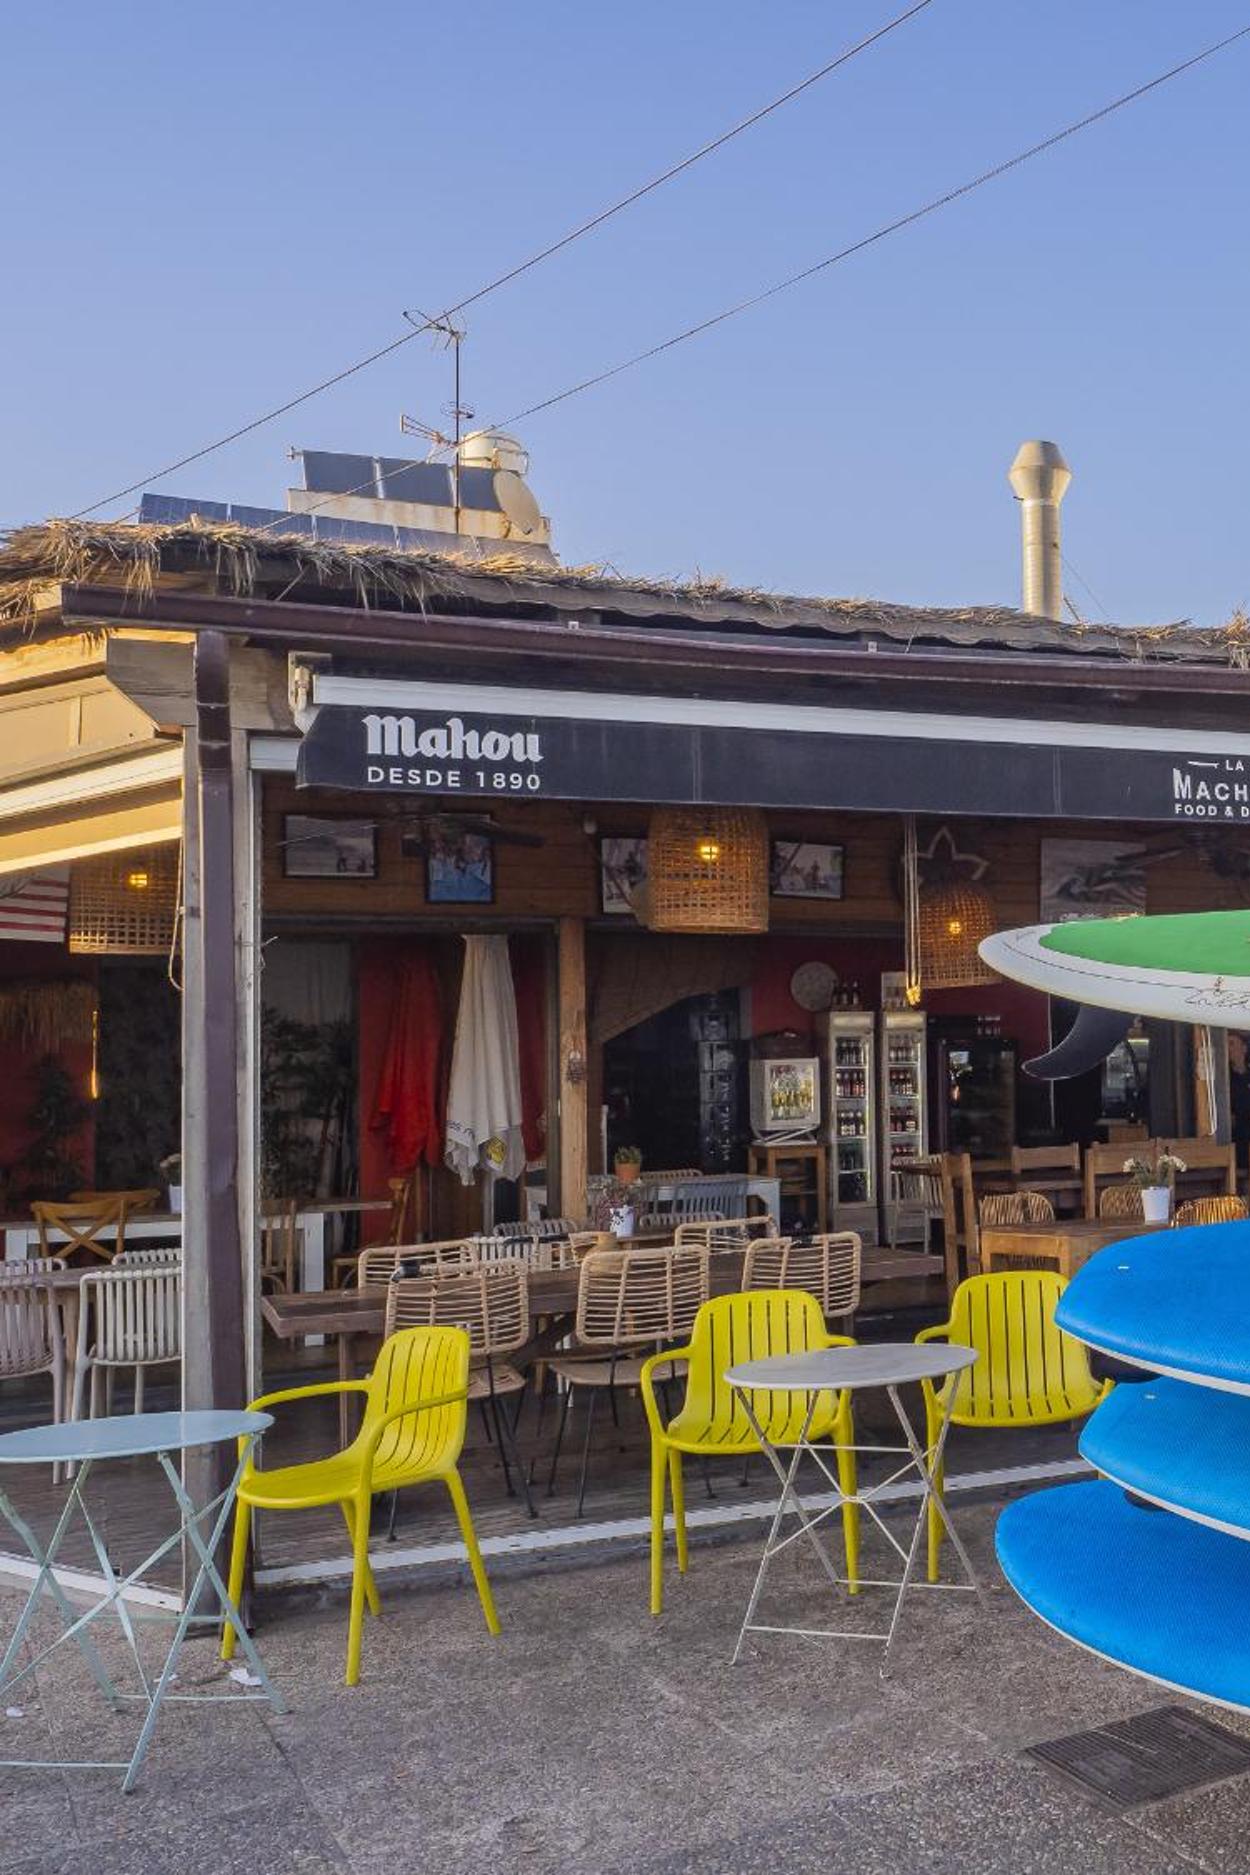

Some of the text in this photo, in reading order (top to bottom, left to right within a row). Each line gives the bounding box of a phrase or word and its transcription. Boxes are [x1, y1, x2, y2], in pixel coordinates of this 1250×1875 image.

[361, 714, 544, 763] Mahou
[1225, 759, 1245, 771] LA
[367, 766, 541, 790] DESDE 1890
[1175, 803, 1217, 816] FOOD
[1224, 805, 1234, 818] &
